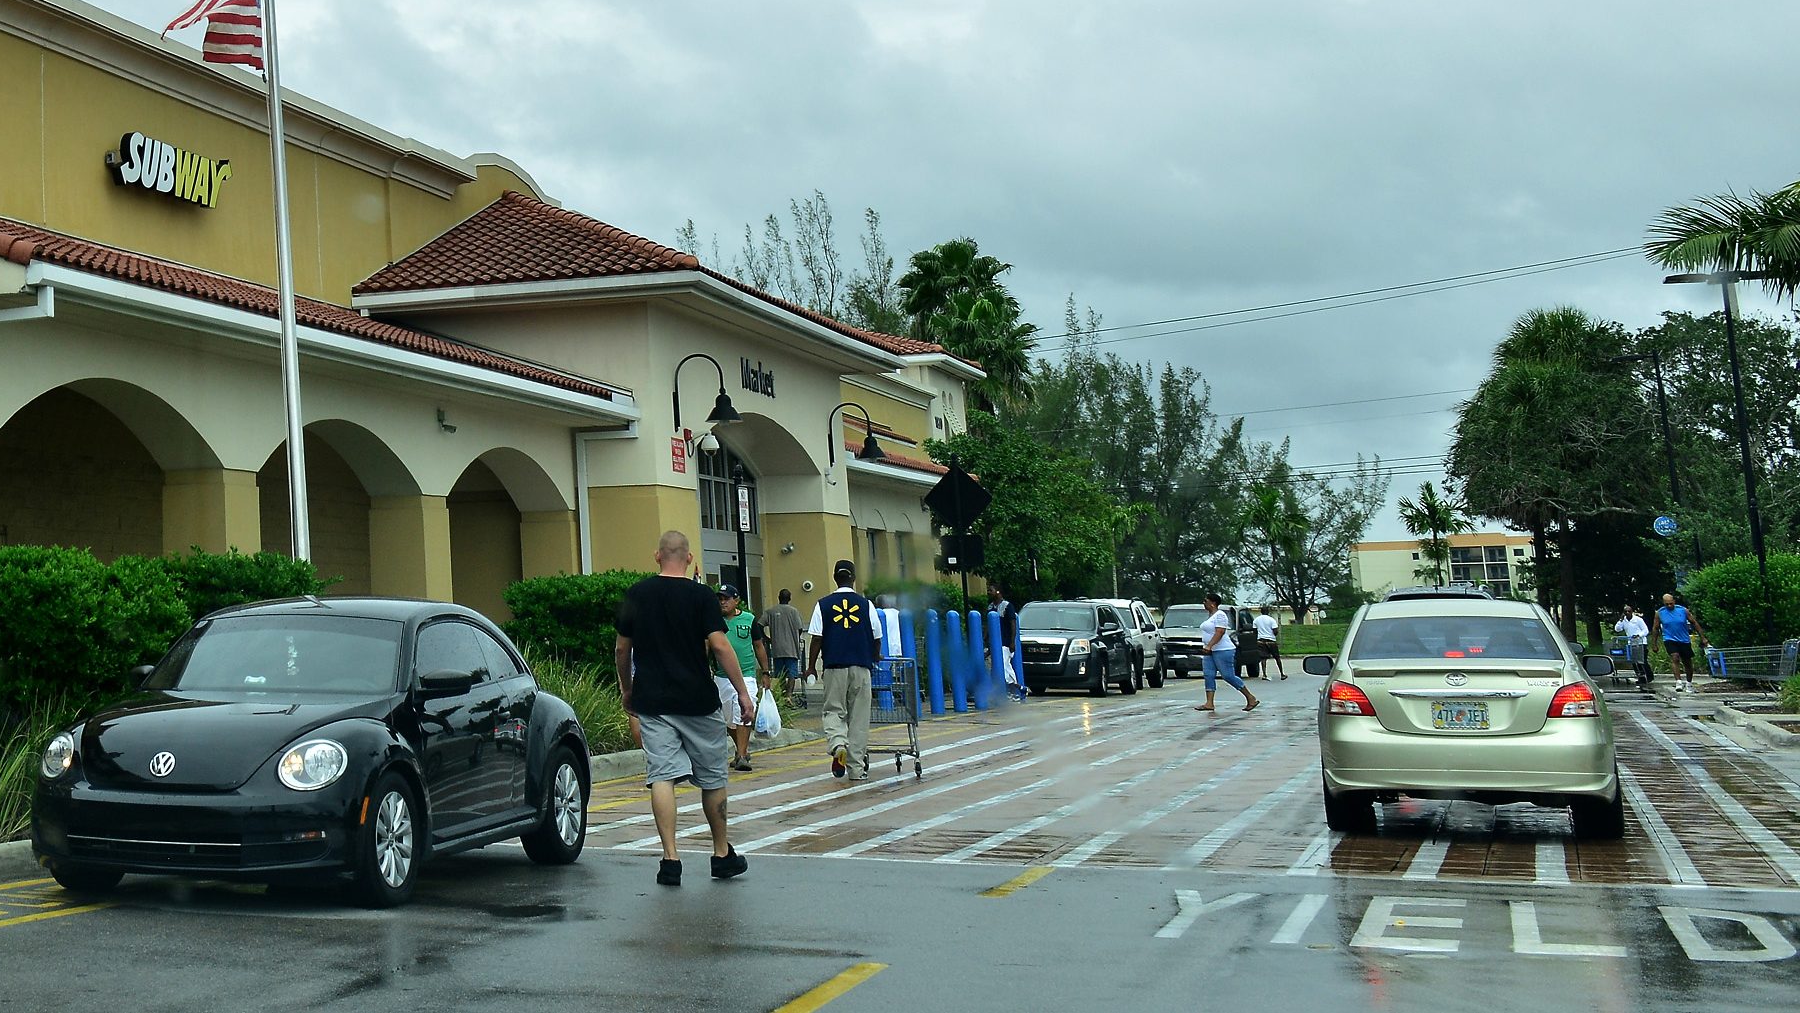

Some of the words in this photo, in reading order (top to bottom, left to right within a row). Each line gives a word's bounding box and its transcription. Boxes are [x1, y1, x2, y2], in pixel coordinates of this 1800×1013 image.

[119, 131, 233, 209] SUBWAY
[740, 356, 776, 399] Market
[1154, 889, 1798, 962] YIELD
